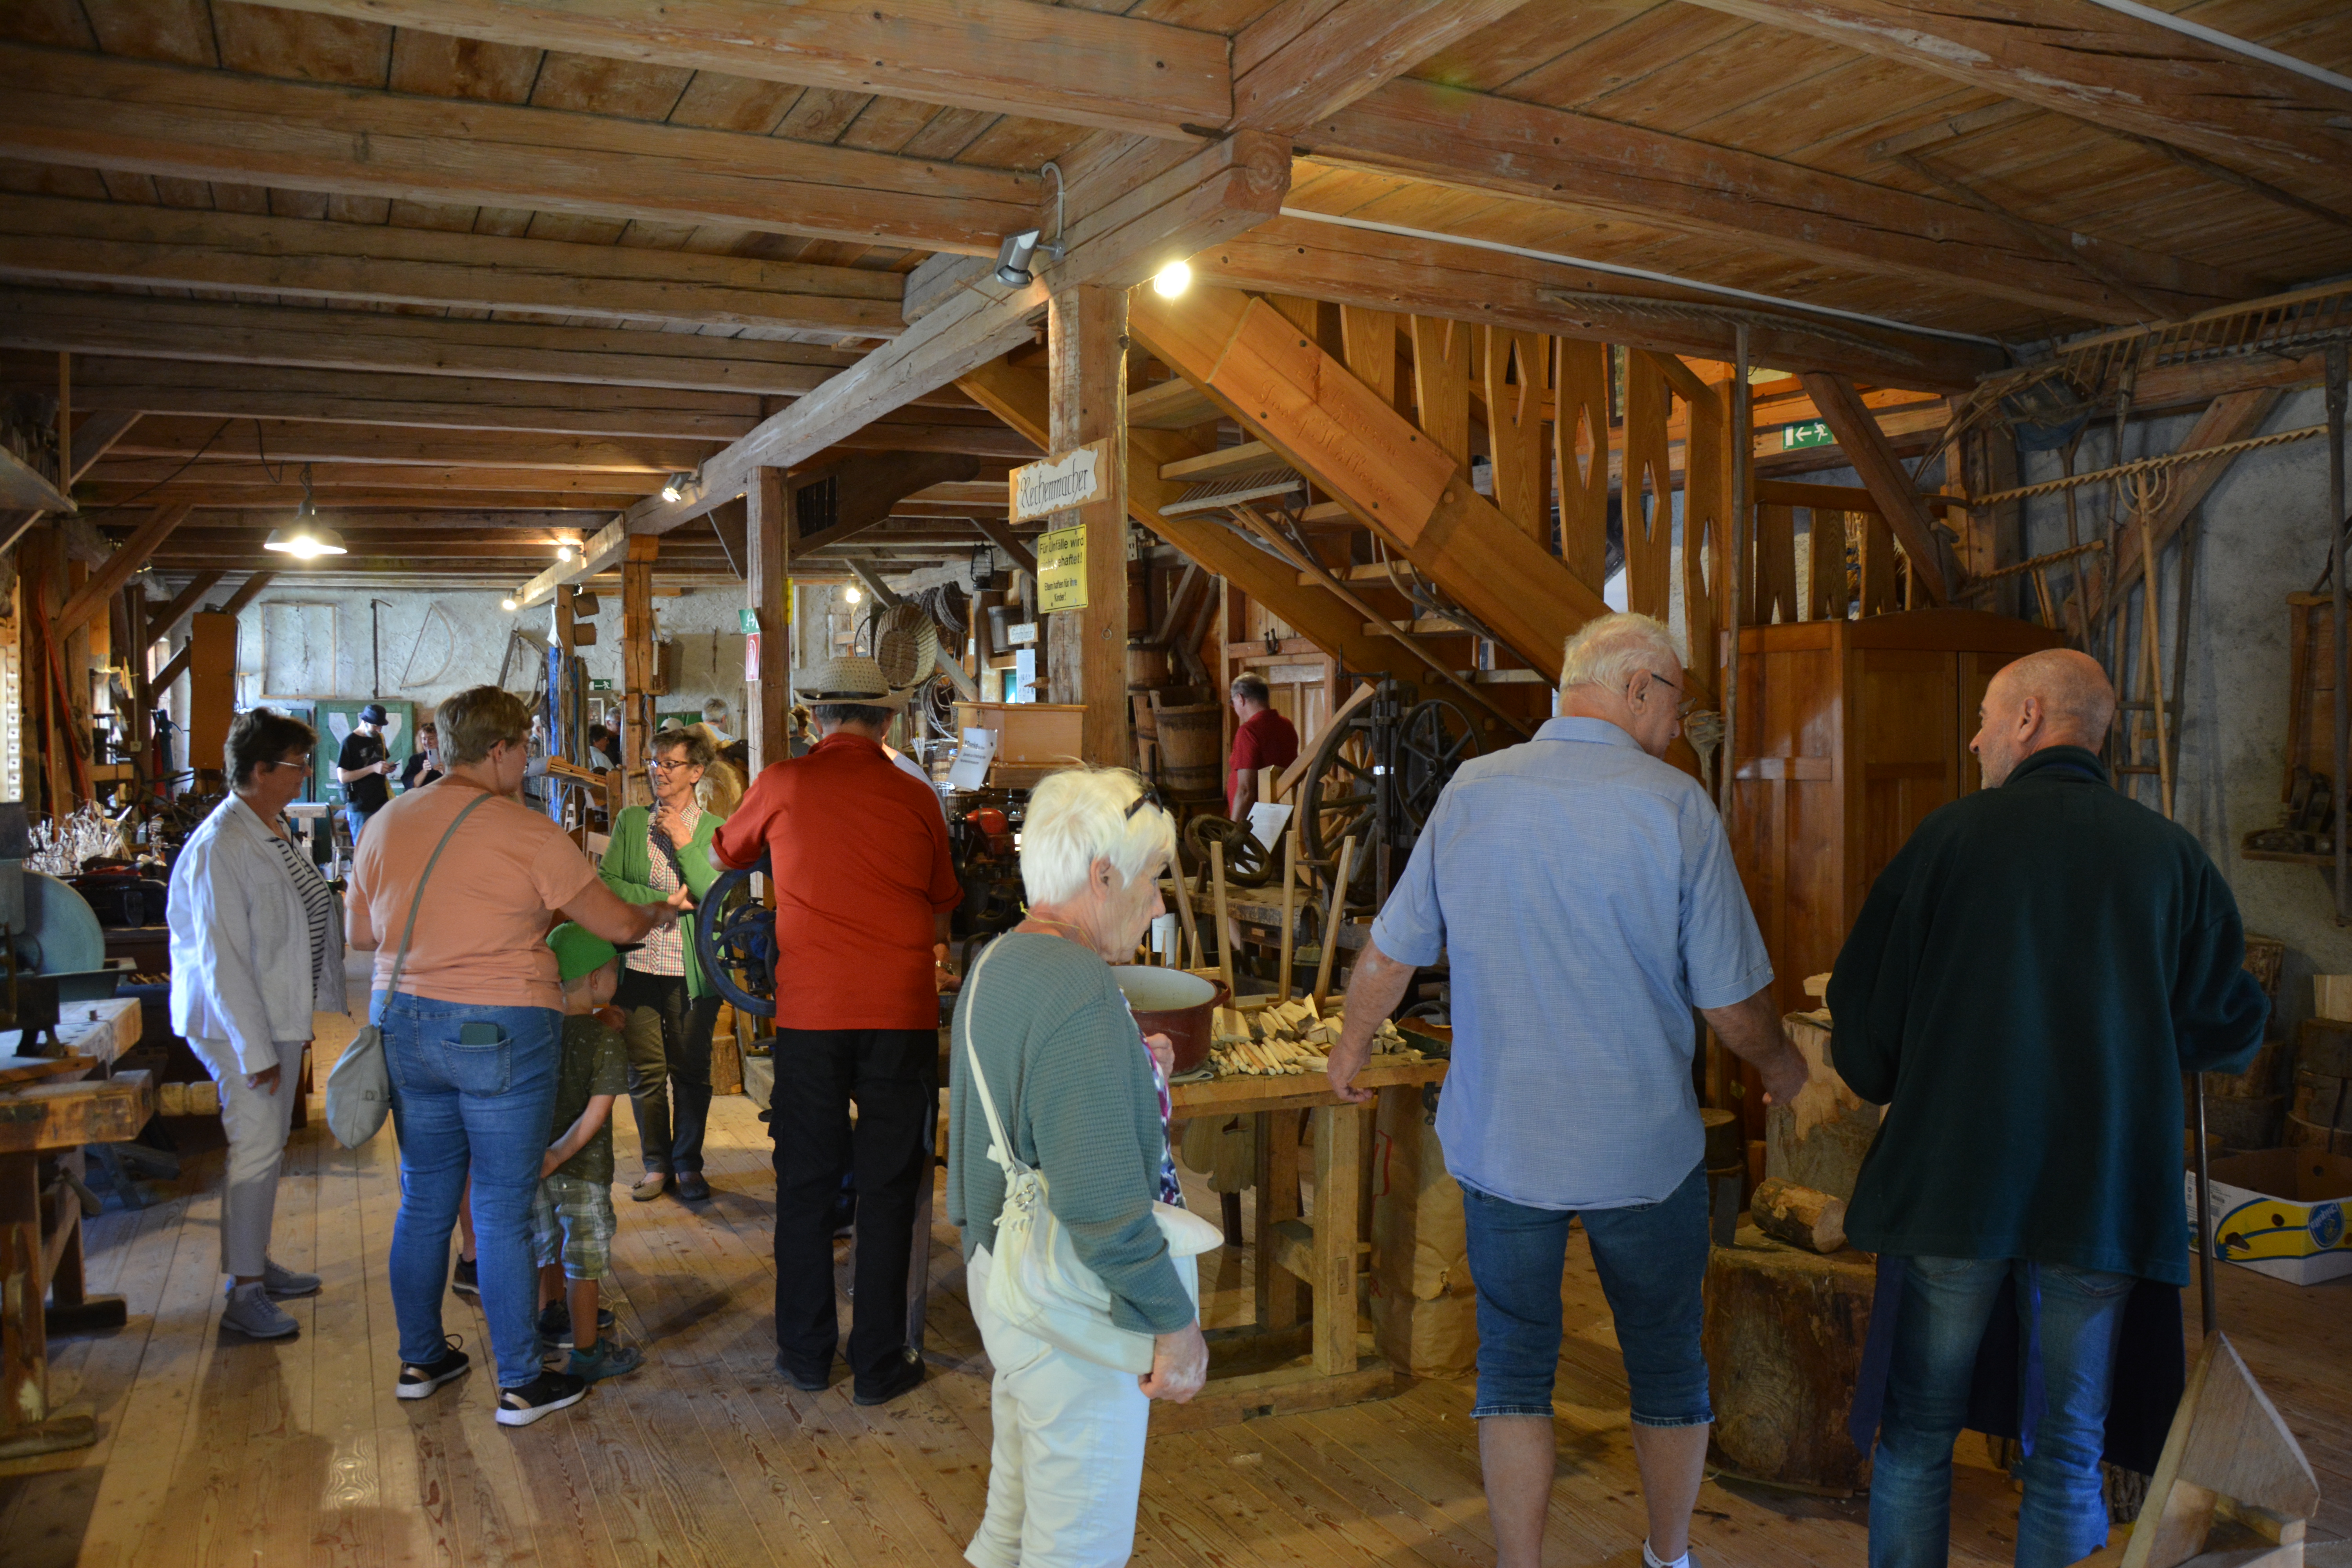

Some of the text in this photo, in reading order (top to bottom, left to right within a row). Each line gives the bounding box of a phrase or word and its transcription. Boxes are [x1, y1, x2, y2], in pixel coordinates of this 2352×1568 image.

[1251, 380, 1316, 438] Josef
[1020, 458, 1089, 514] Rechenmacher
[1040, 535, 1084, 554] Für Unfälle wird
[1054, 552, 1082, 570] ehaftet!
[1053, 580, 1063, 589] haften
